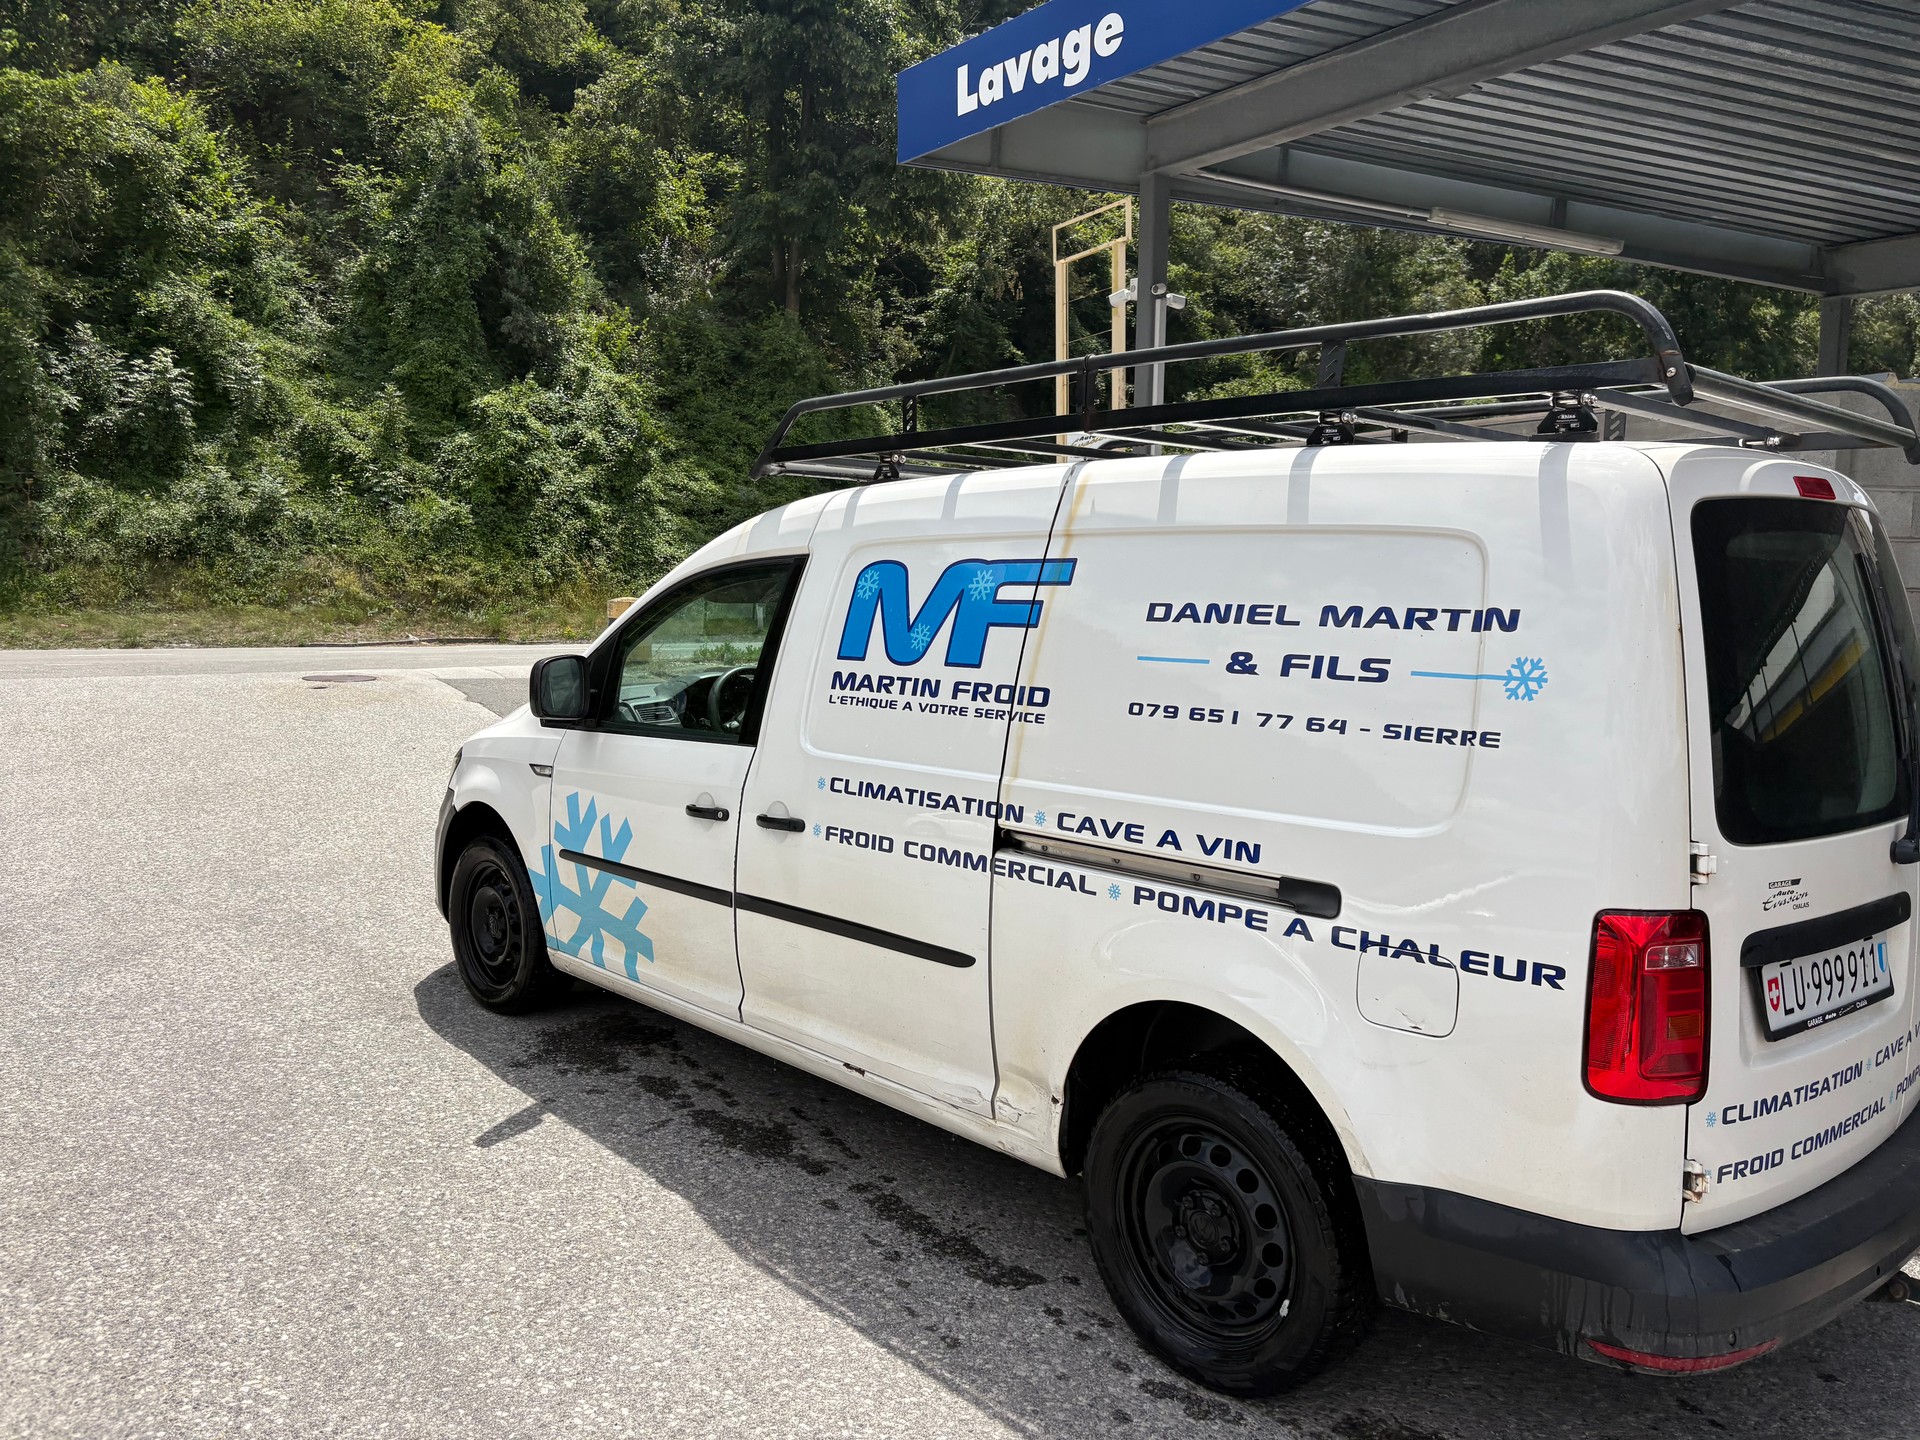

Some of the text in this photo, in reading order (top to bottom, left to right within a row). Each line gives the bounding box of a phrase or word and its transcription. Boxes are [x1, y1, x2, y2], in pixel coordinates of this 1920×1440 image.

[957, 12, 1125, 117] Lavage
[836, 557, 1078, 669] MF
[1145, 602, 1521, 633] DANIEL MARTIN
[831, 671, 1051, 708] MARTIN FROID
[1225, 651, 1392, 683] & FILS
[902, 702, 913, 712] A
[918, 703, 969, 717] VOTRE
[973, 708, 1046, 725] SERVICE
[1128, 702, 1179, 719] 079
[1189, 707, 1239, 725] 651
[1256, 712, 1294, 729] 77
[1305, 717, 1348, 735] 64
[1382, 724, 1501, 748] SIERRE
[829, 776, 1262, 864] CLIMATISATION CAVE A VIN
[825, 825, 1566, 991] FROID COMMERCIAL POMPE A CHALEUR
[1721, 1060, 1863, 1125] CLIMATISATION
[1875, 1036, 1904, 1067] CAVE
[1905, 1030, 1912, 1047] A
[1716, 1148, 1784, 1184] FROID
[1791, 1097, 1886, 1160] COMMERCIAL
